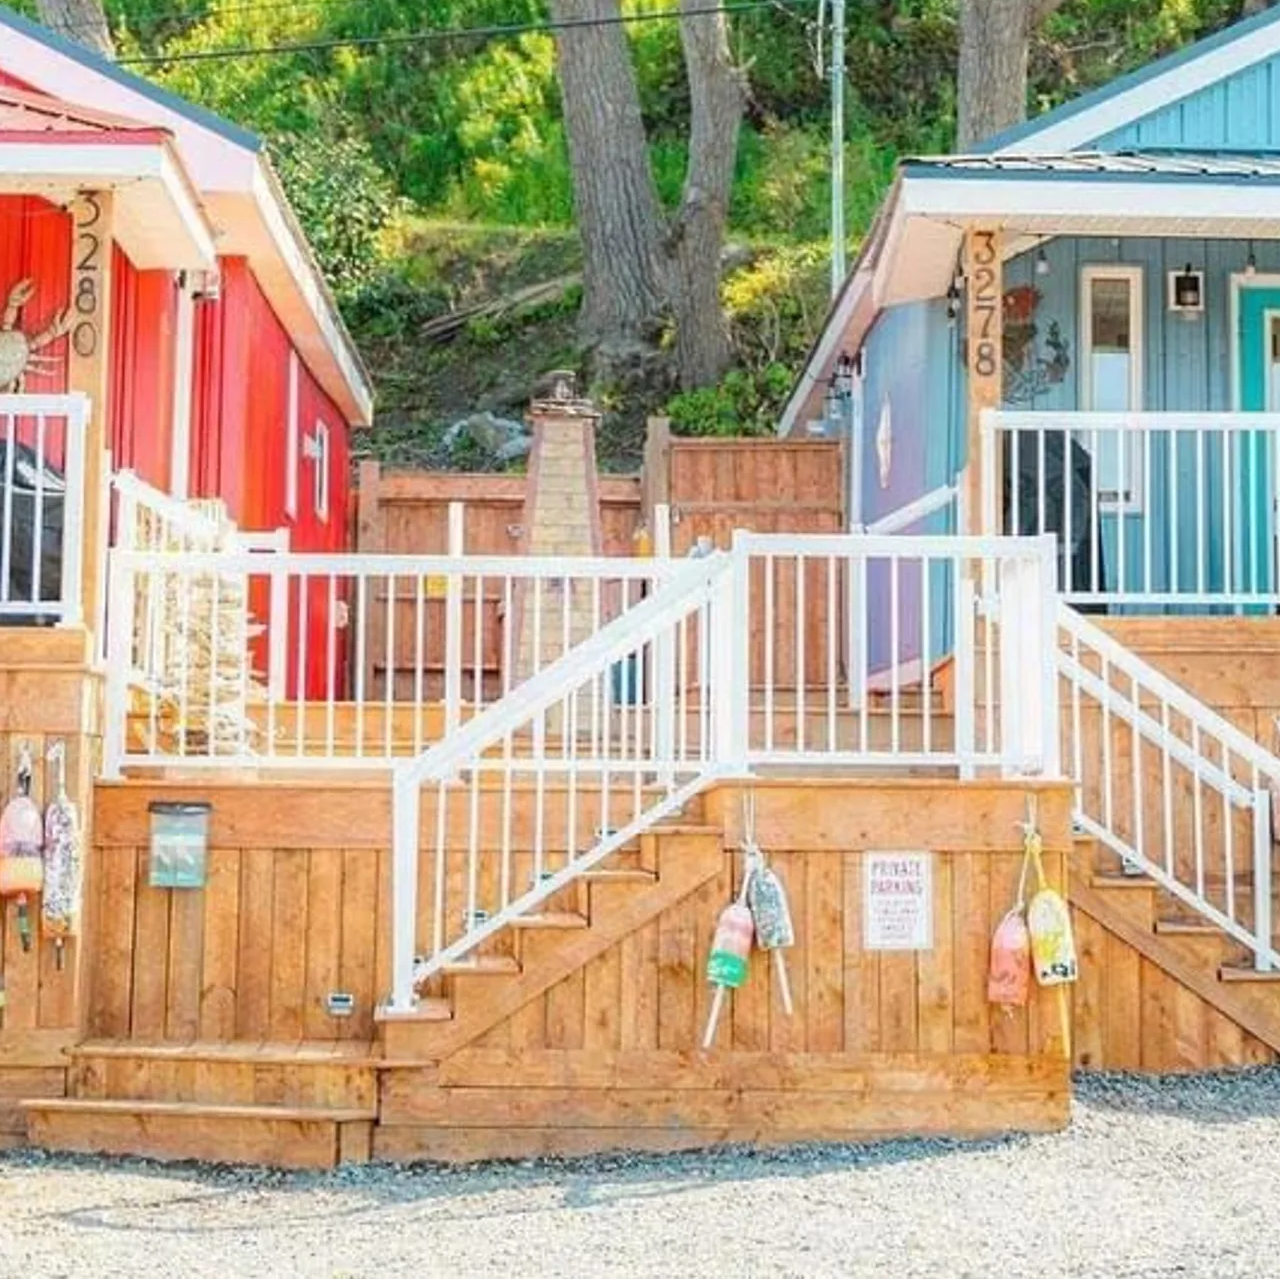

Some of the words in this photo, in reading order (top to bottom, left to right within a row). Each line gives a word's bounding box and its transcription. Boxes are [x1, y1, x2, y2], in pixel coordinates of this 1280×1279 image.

[73, 189, 100, 358] 3280
[974, 231, 996, 377] 3278
[871, 860, 921, 877] PRIVATE
